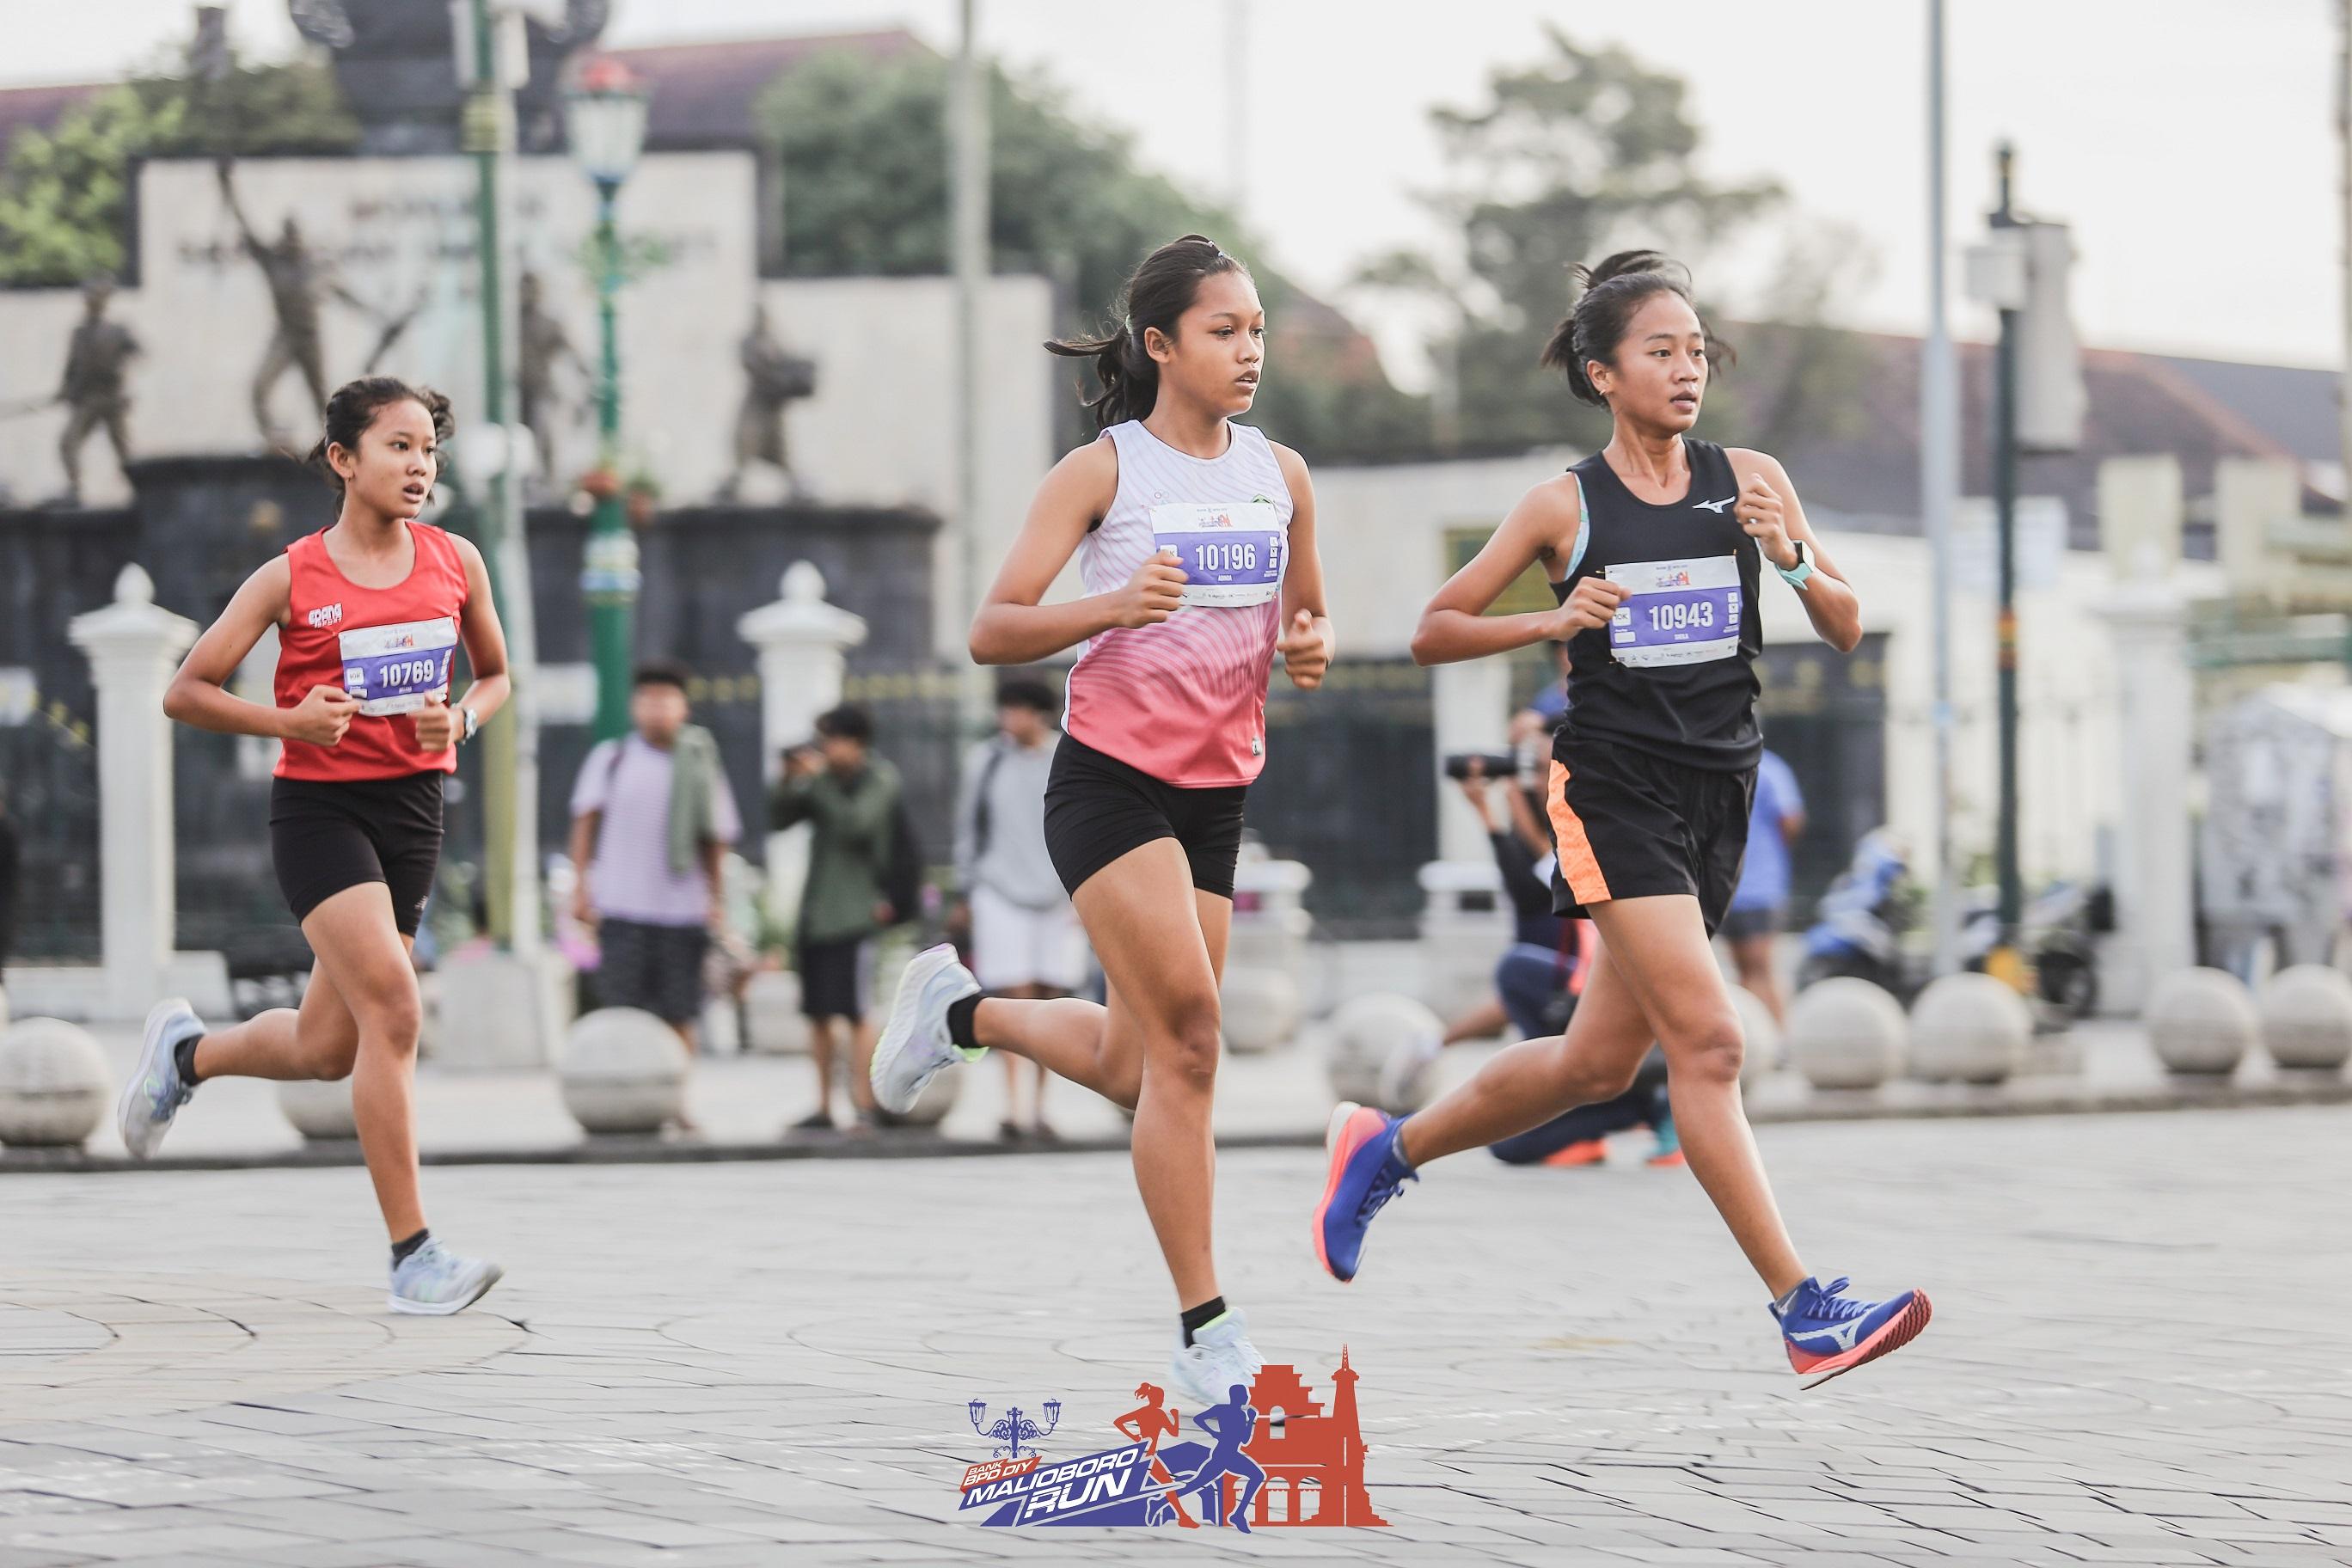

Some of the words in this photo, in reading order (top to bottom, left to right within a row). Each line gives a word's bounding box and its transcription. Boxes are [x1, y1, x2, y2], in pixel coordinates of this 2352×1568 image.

[1195, 543, 1256, 571] 10196
[1649, 601, 1714, 631] 10943
[379, 658, 434, 688] 10769
